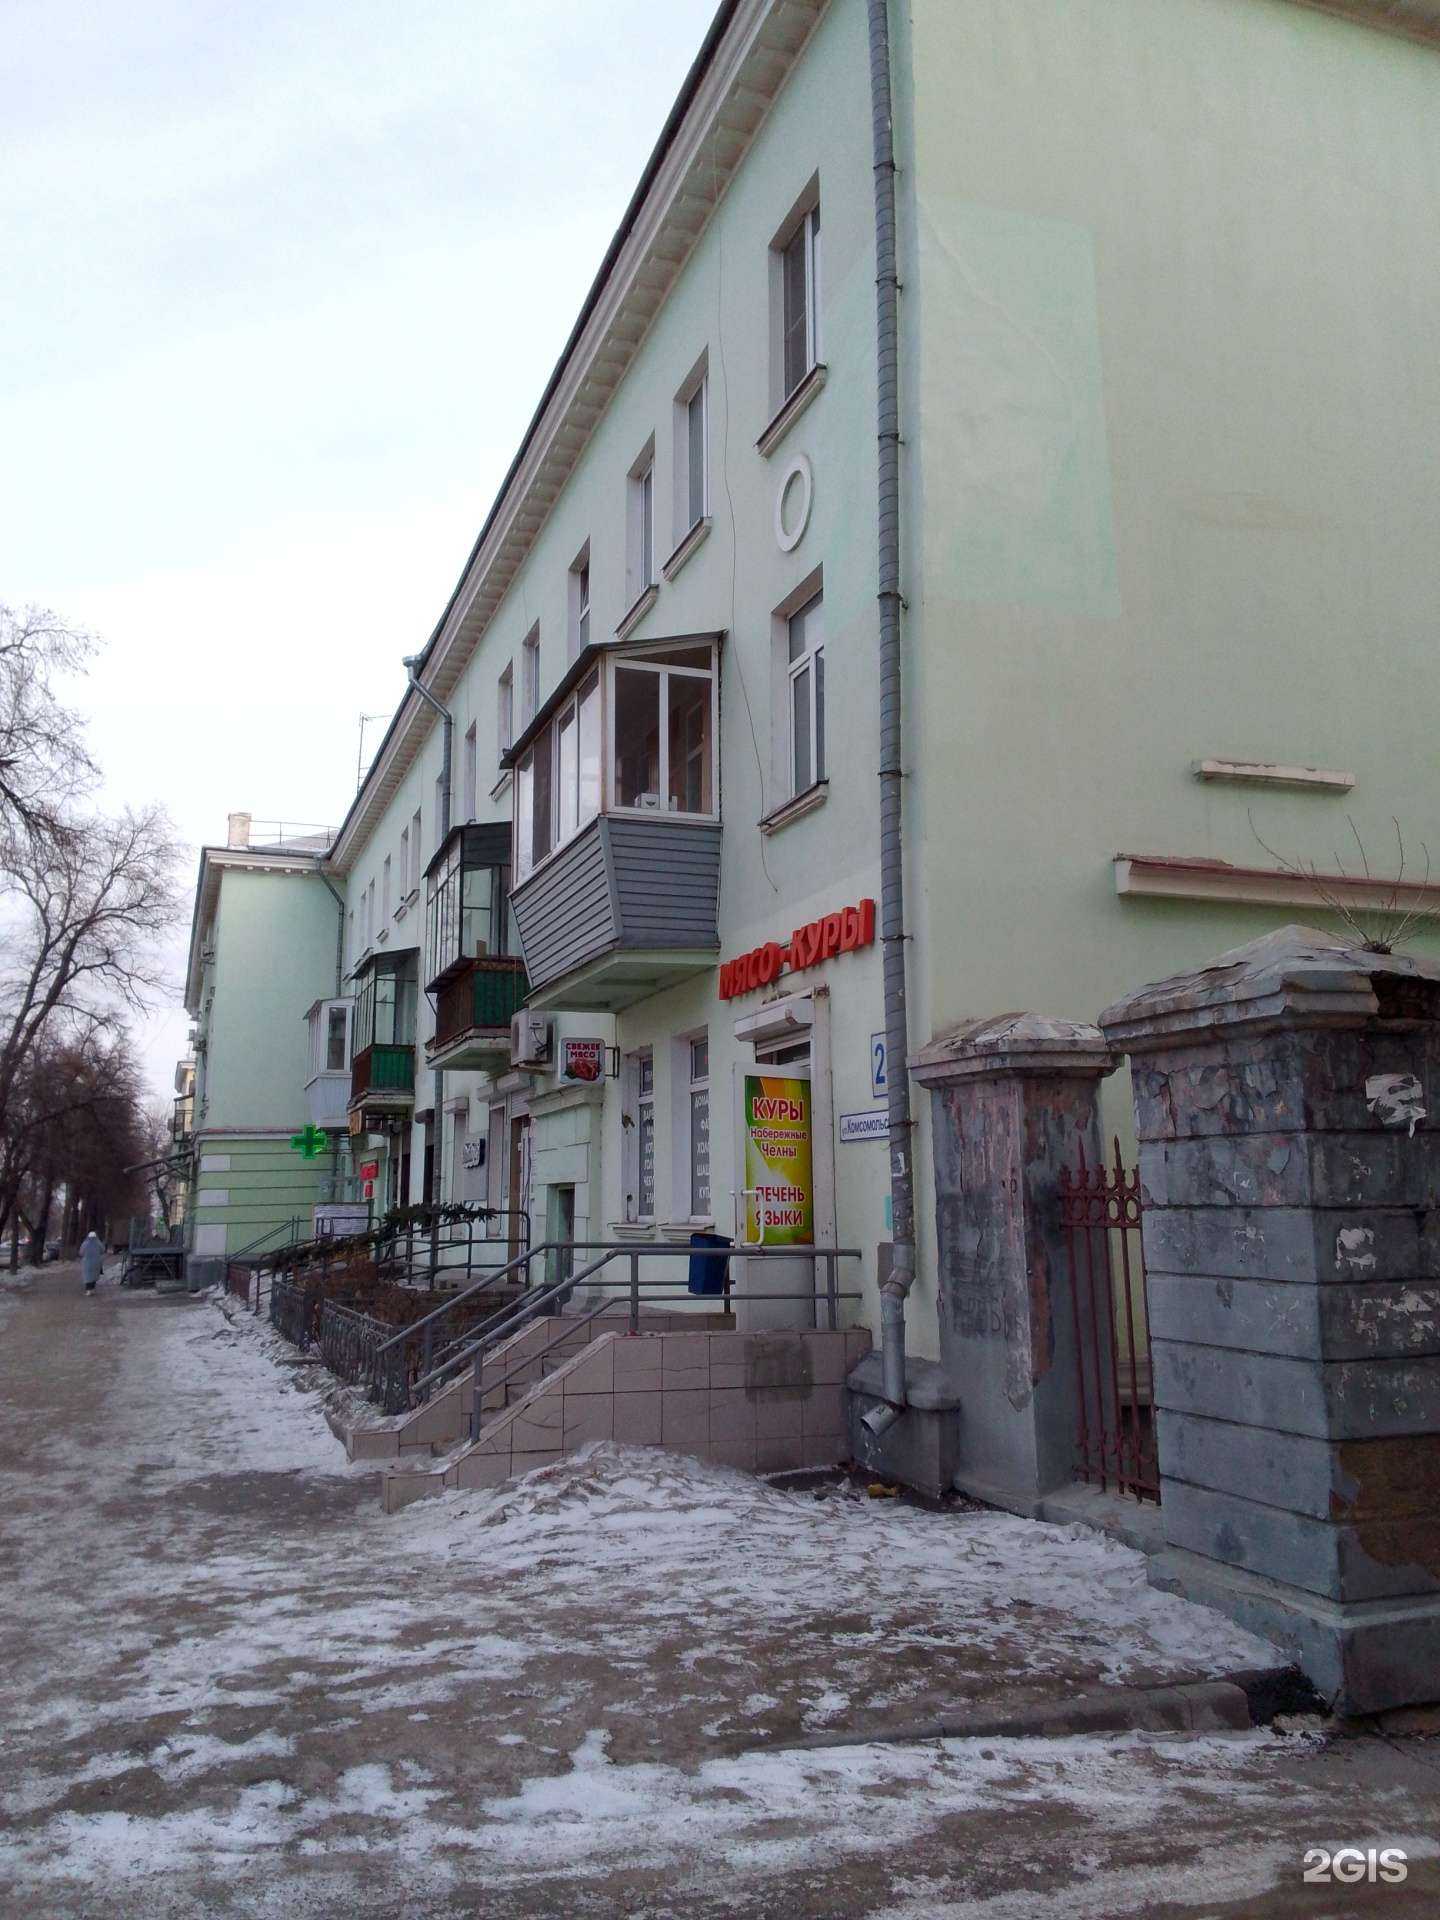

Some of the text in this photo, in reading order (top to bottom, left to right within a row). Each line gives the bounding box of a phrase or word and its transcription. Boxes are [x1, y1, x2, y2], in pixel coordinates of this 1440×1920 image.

[875, 1043, 886, 1085] 2
[753, 1098, 804, 1121] КУРЫ
[750, 1126, 807, 1141] Набережные
[762, 1143, 797, 1158] Челны
[755, 1186, 805, 1202] ПЕЧЕНЬ
